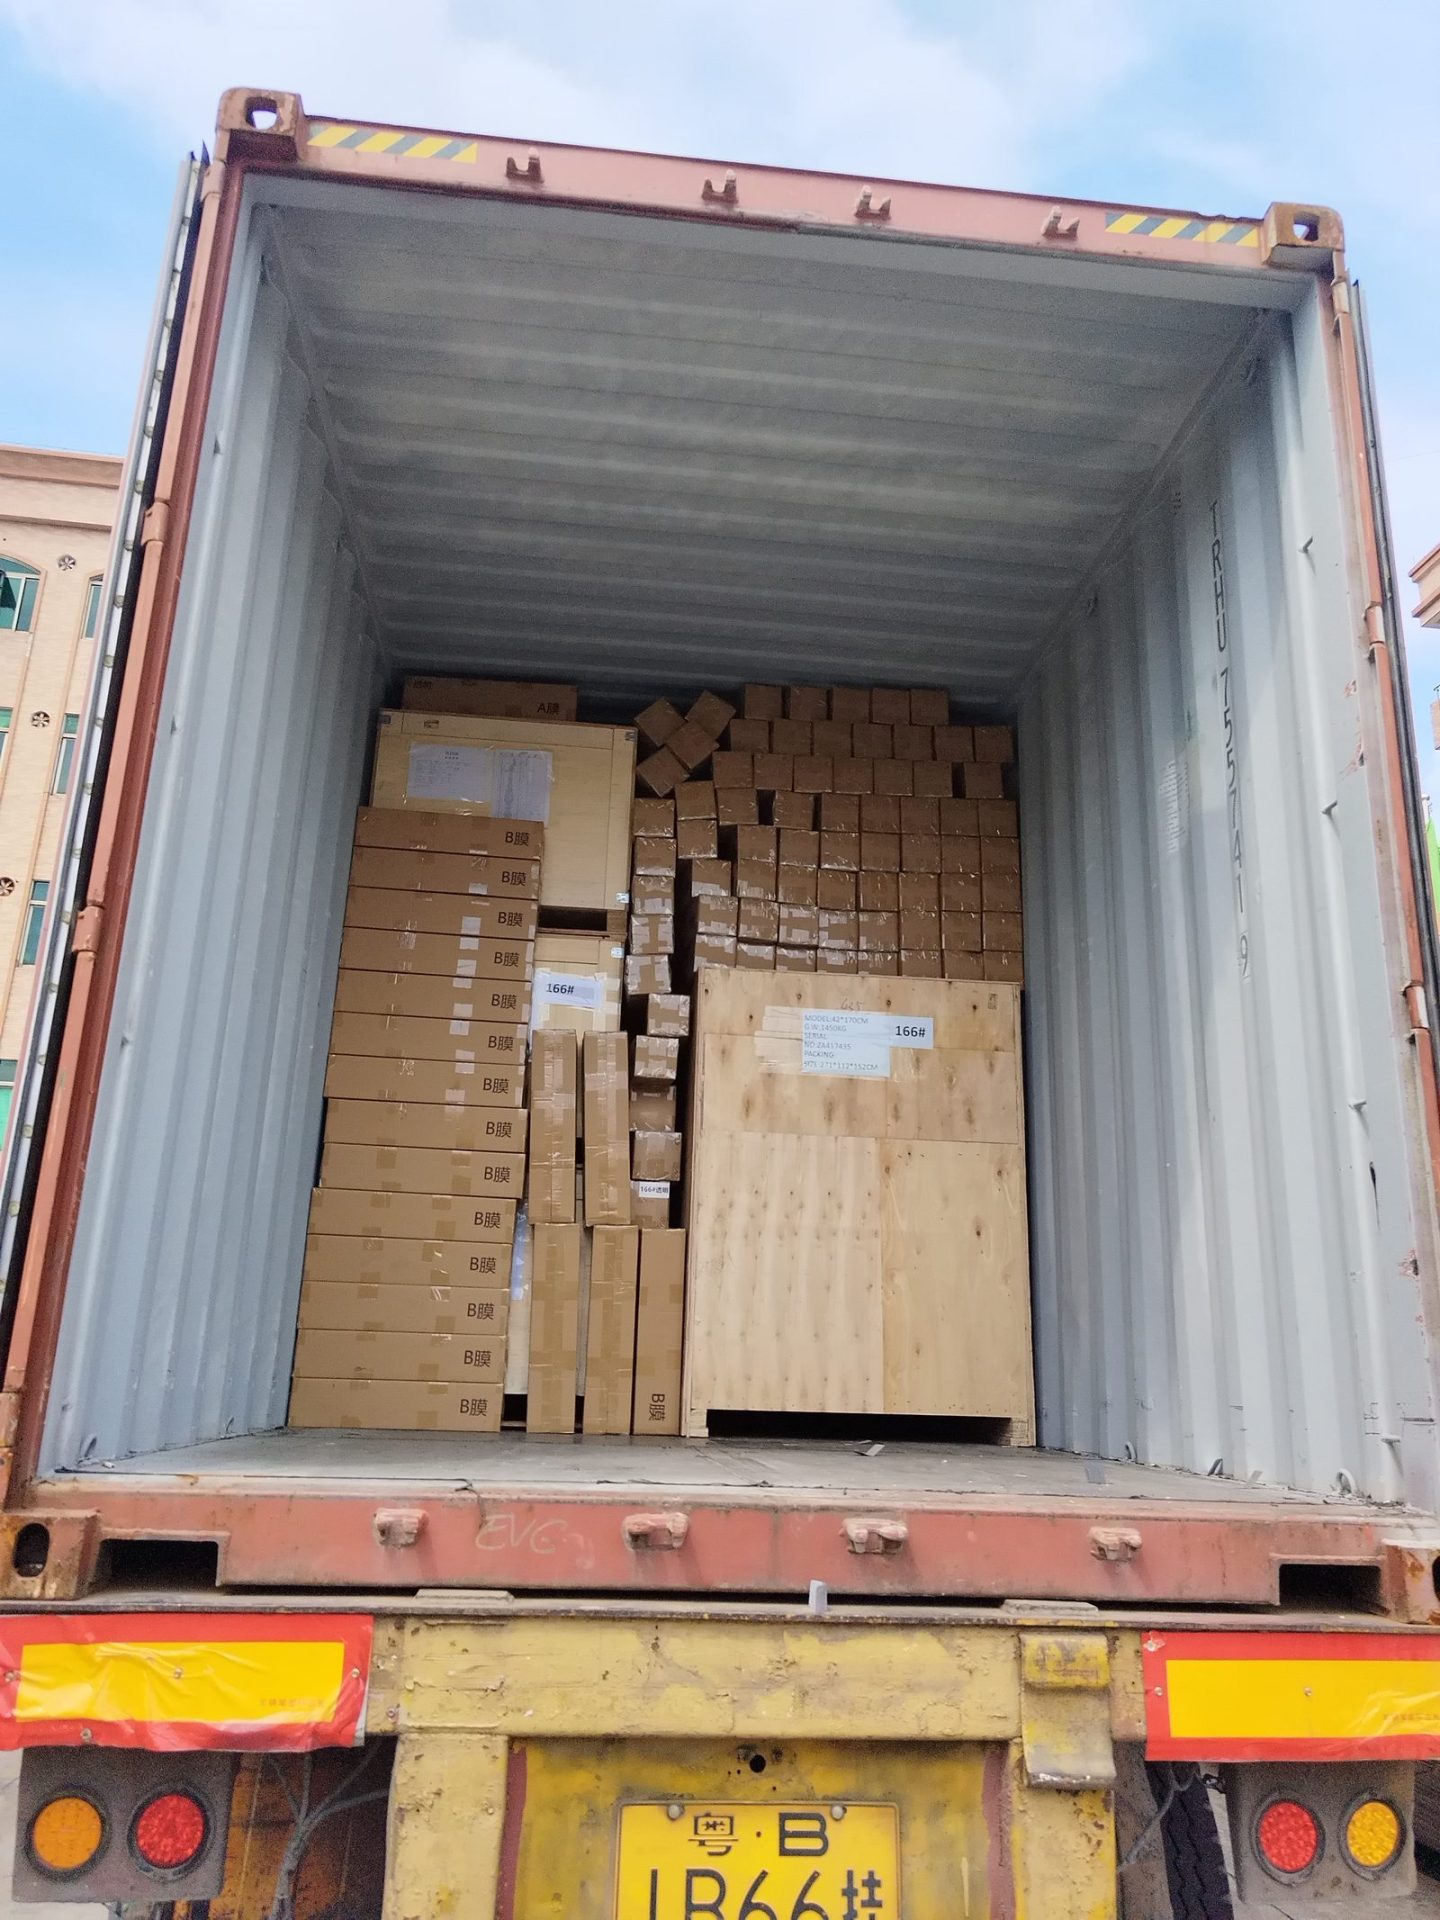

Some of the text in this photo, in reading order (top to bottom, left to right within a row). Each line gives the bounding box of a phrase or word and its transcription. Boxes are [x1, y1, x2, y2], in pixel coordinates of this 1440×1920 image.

[1208, 501, 1250, 976] TRHU 755741 9
[505, 831, 530, 847] B膜
[502, 870, 527, 886] B膜
[498, 911, 524, 927] B膜
[494, 951, 520, 968] B膜
[546, 983, 575, 995] 166#
[491, 993, 517, 1010] B膜
[895, 1026, 926, 1038] 166#
[487, 1035, 514, 1052] B膜
[804, 1049, 834, 1058] PACKING
[483, 1077, 510, 1094] B膜
[485, 1121, 513, 1139] B膜
[483, 1166, 511, 1184] B膜
[474, 1211, 501, 1229] B膜
[469, 1256, 497, 1274] B膜
[466, 1302, 494, 1320] B膜
[463, 1350, 491, 1368] B膜
[459, 1398, 488, 1417] B膜
[648, 1393, 666, 1421] B膜
